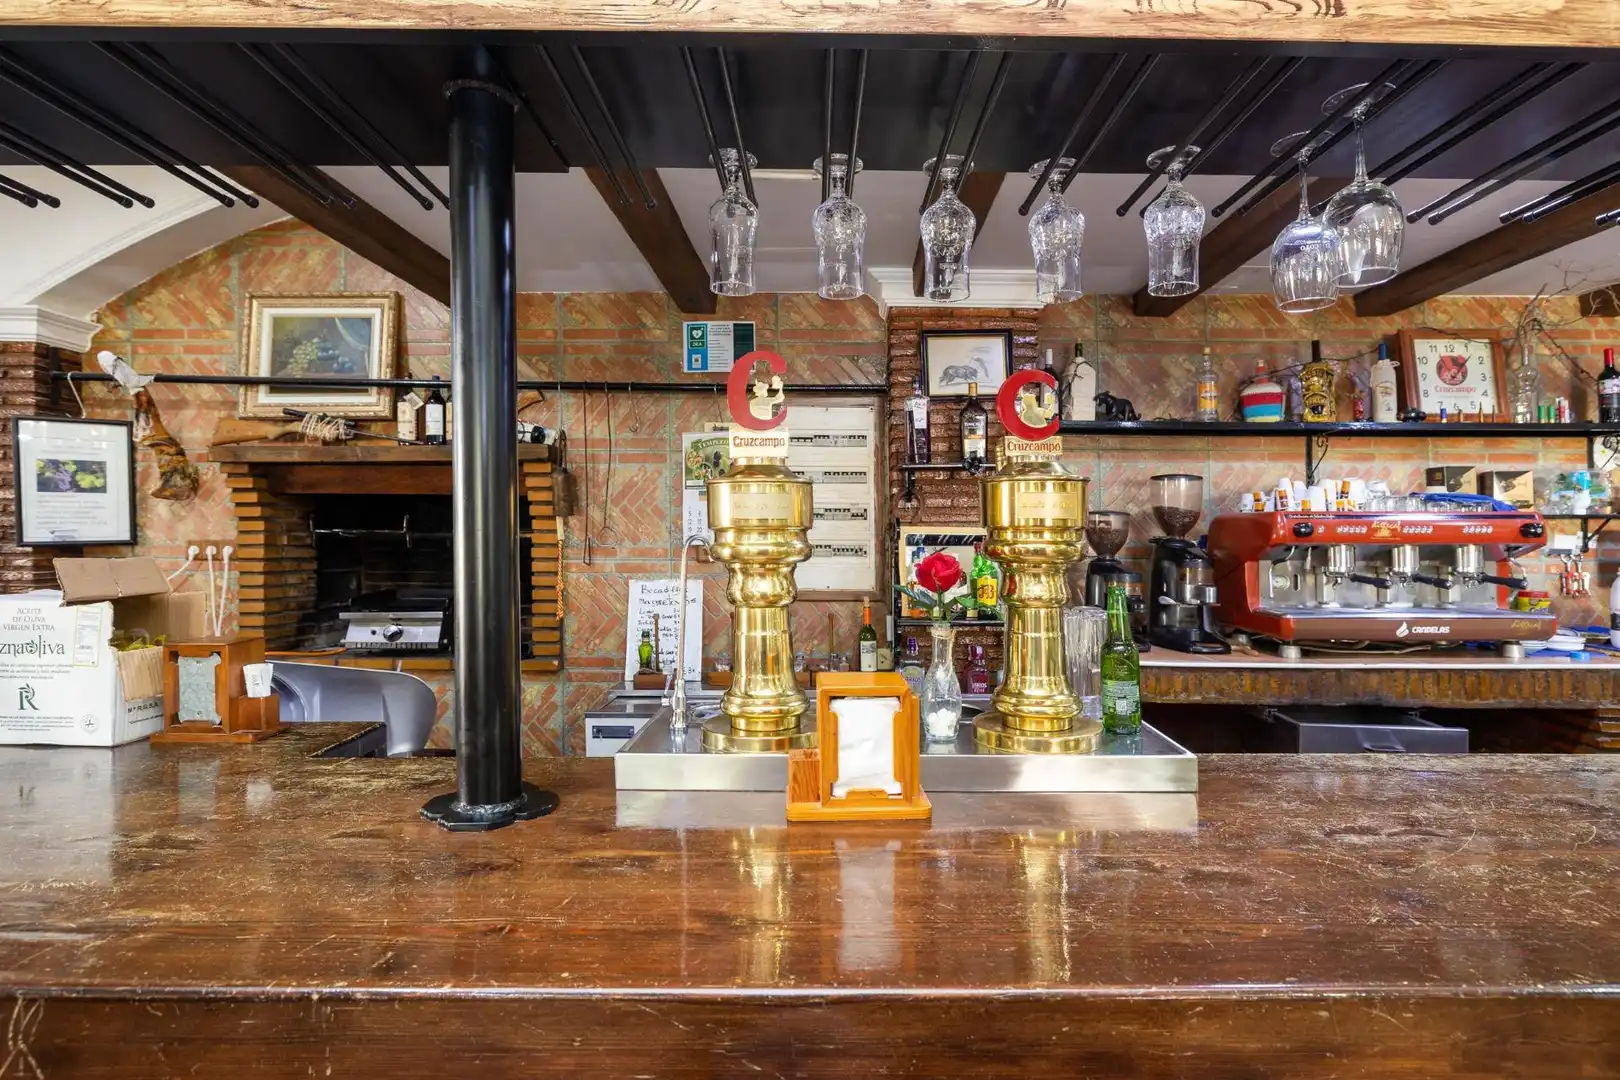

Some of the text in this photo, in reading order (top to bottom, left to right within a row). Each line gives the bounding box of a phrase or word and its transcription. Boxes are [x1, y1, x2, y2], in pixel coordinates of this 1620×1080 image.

[1429, 343, 1469, 353] 11 12 1
[1417, 356, 1428, 365] 10
[1477, 356, 1485, 365] 2
[1421, 373, 1427, 381] 9
[1480, 373, 1487, 381] 3
[1423, 389, 1429, 398] 8
[1434, 385, 1476, 394] Cruzcampo
[1481, 389, 1488, 397] 4
[1453, 403, 1460, 411] 6
[1470, 401, 1476, 410] 5
[733, 436, 786, 448] Cruzcampo
[1007, 441, 1061, 453] Cruzcampo
[23, 615, 47, 623] OLIVA
[1412, 626, 1450, 634] CANDELAS
